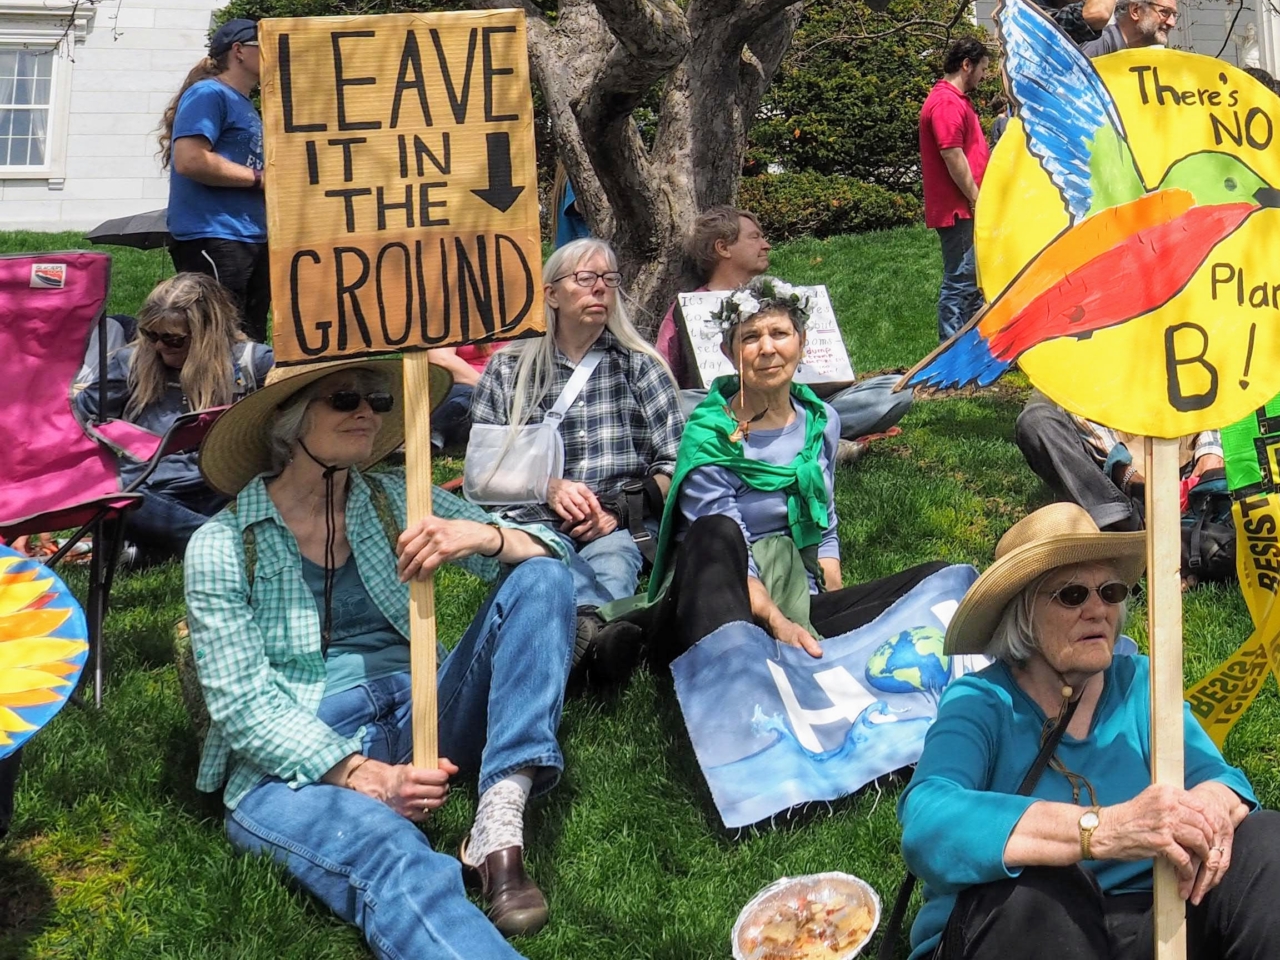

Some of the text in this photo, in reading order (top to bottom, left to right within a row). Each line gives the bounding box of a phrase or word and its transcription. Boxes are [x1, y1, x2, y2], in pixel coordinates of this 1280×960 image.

[278, 26, 519, 133] LEAVE
[1128, 66, 1239, 108] There's
[1209, 106, 1274, 151] NO
[305, 132, 451, 185] IT IN
[325, 181, 450, 233] THE
[290, 233, 535, 356] GROUND
[681, 295, 703, 308] It's
[700, 360, 722, 372] day
[1164, 322, 1257, 413] B!
